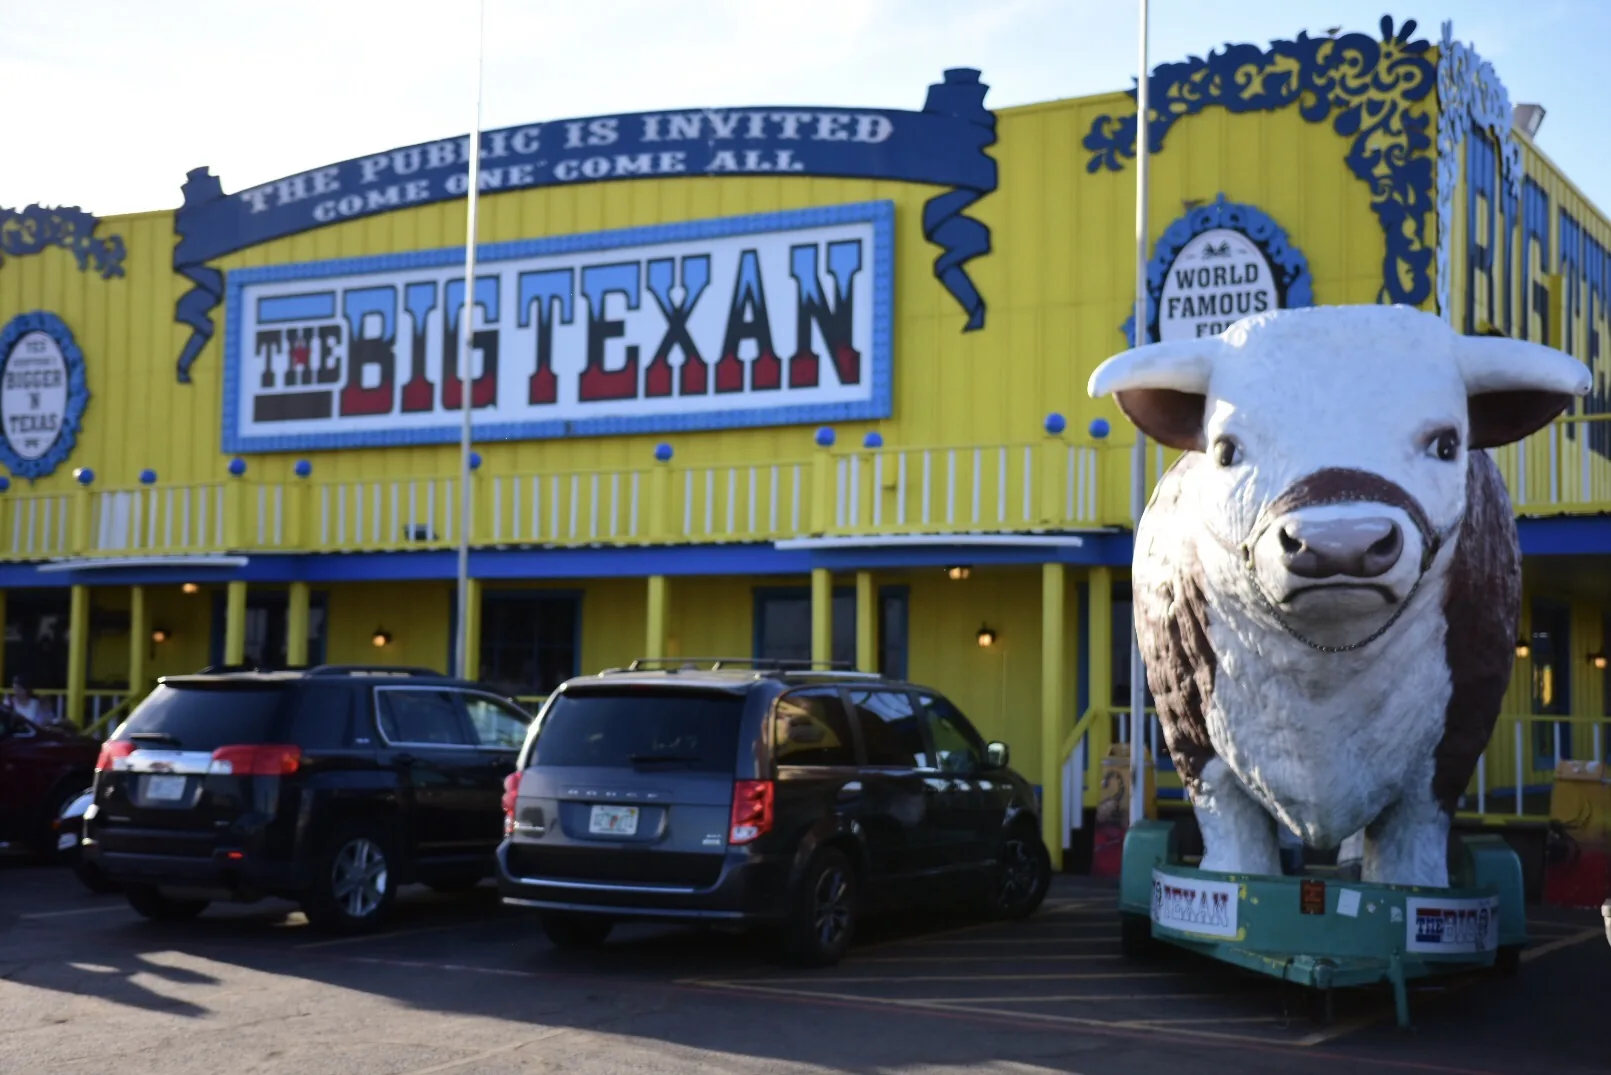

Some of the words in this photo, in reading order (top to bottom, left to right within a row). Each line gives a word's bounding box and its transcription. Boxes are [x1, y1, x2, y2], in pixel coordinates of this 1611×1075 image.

[241, 165, 341, 214] THE
[359, 126, 541, 184] PUBLIC
[563, 117, 618, 149] IS
[639, 112, 893, 144] INVITED
[312, 179, 429, 222] COME
[553, 150, 687, 182] COME
[705, 149, 804, 173] ALL
[1175, 263, 1259, 290] WORLD
[1167, 291, 1268, 319] FAMOUS
[254, 323, 341, 389] THE
[338, 274, 500, 417] BIG
[517, 238, 863, 405] TEXAN
[1163, 885, 1229, 928] TEXAN
[1416, 917, 1443, 934] THE
